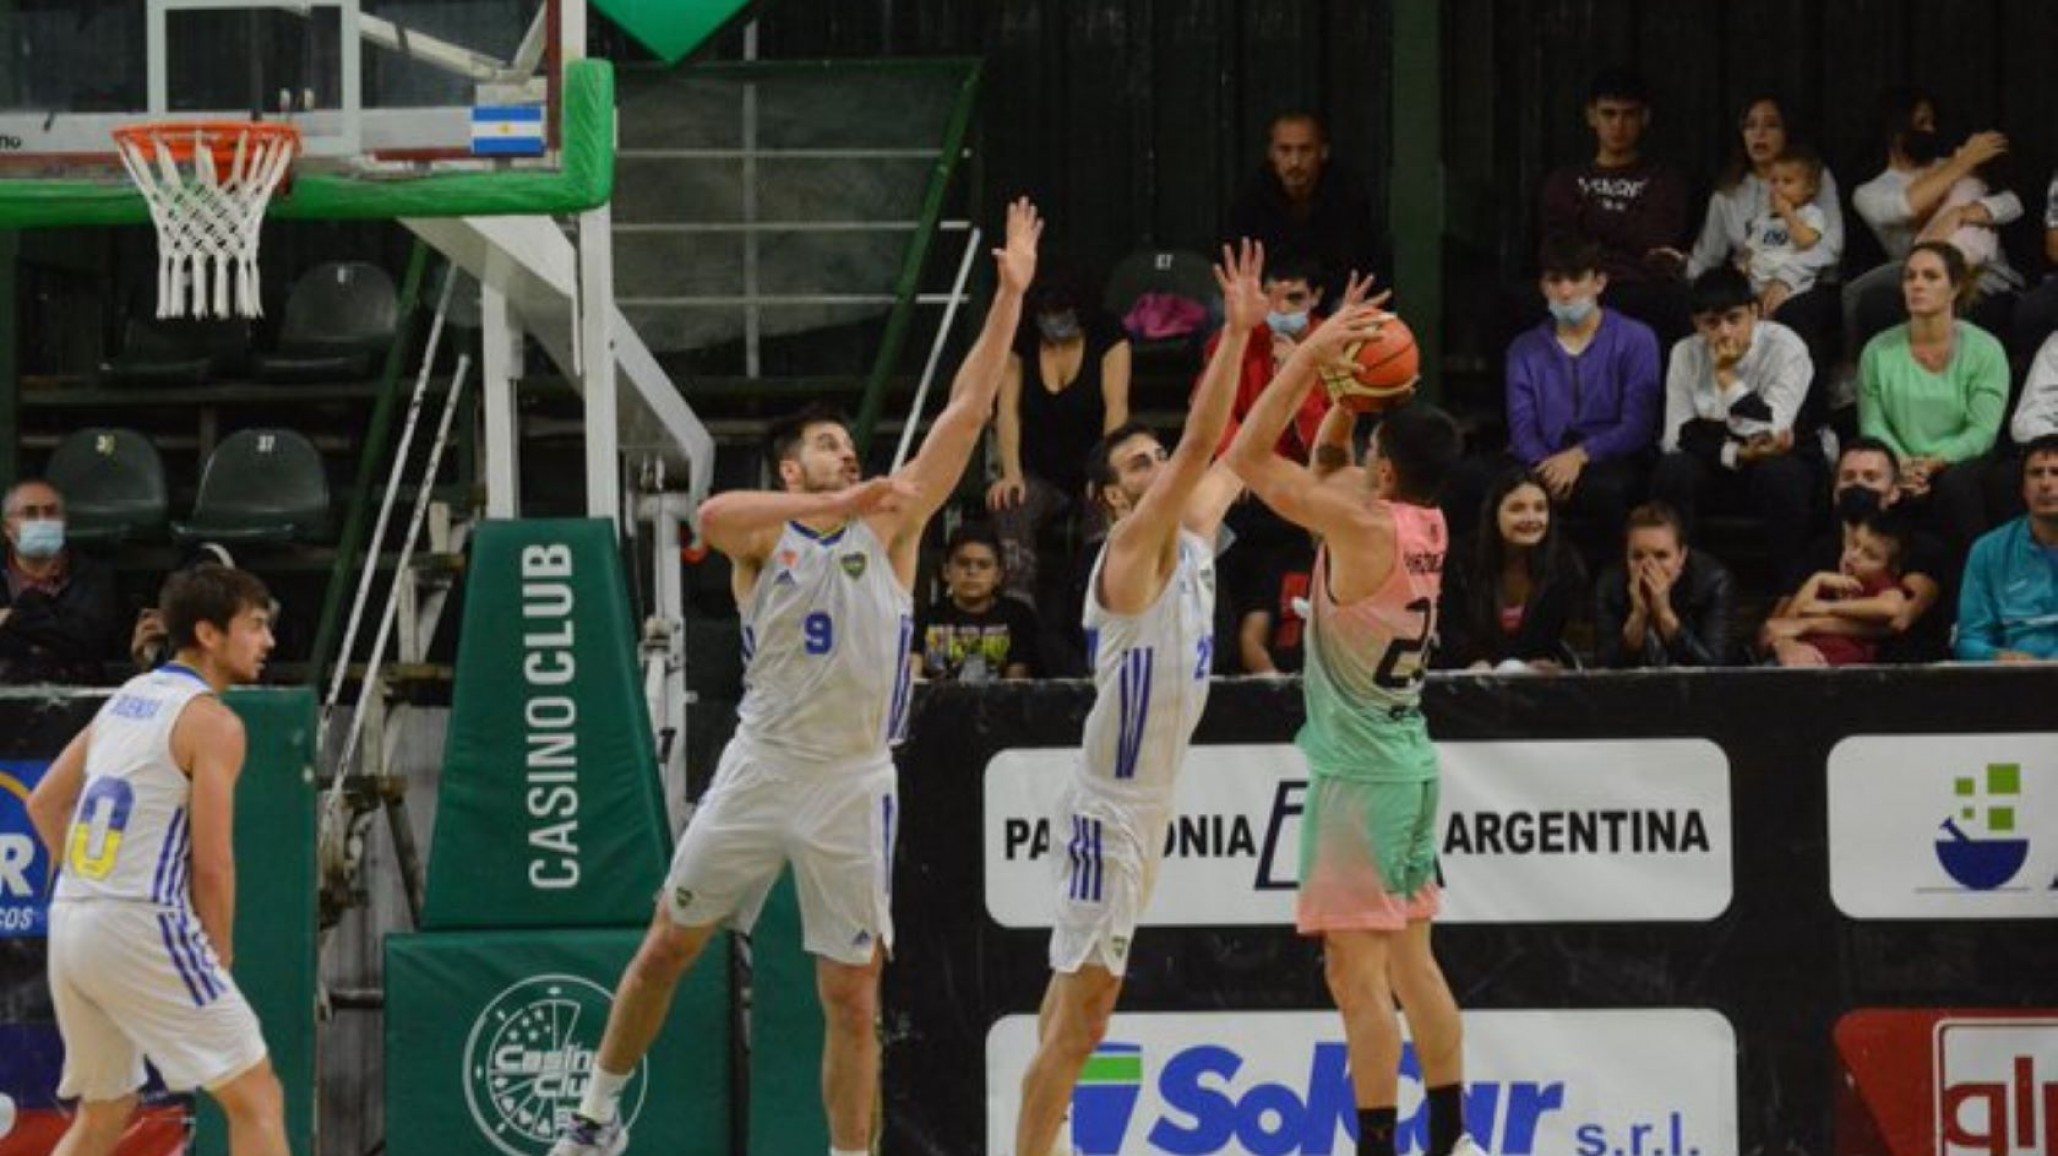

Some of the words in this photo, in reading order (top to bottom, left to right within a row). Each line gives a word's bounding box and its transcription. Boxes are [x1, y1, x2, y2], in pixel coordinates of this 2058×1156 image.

[521, 543, 576, 686] CLUB
[804, 610, 833, 655] 9
[71, 776, 135, 881] 0
[525, 695, 580, 889] CASINO
[1442, 809, 1711, 854] ARGENTINA
[1575, 1112, 1701, 1156] s.r.l.
